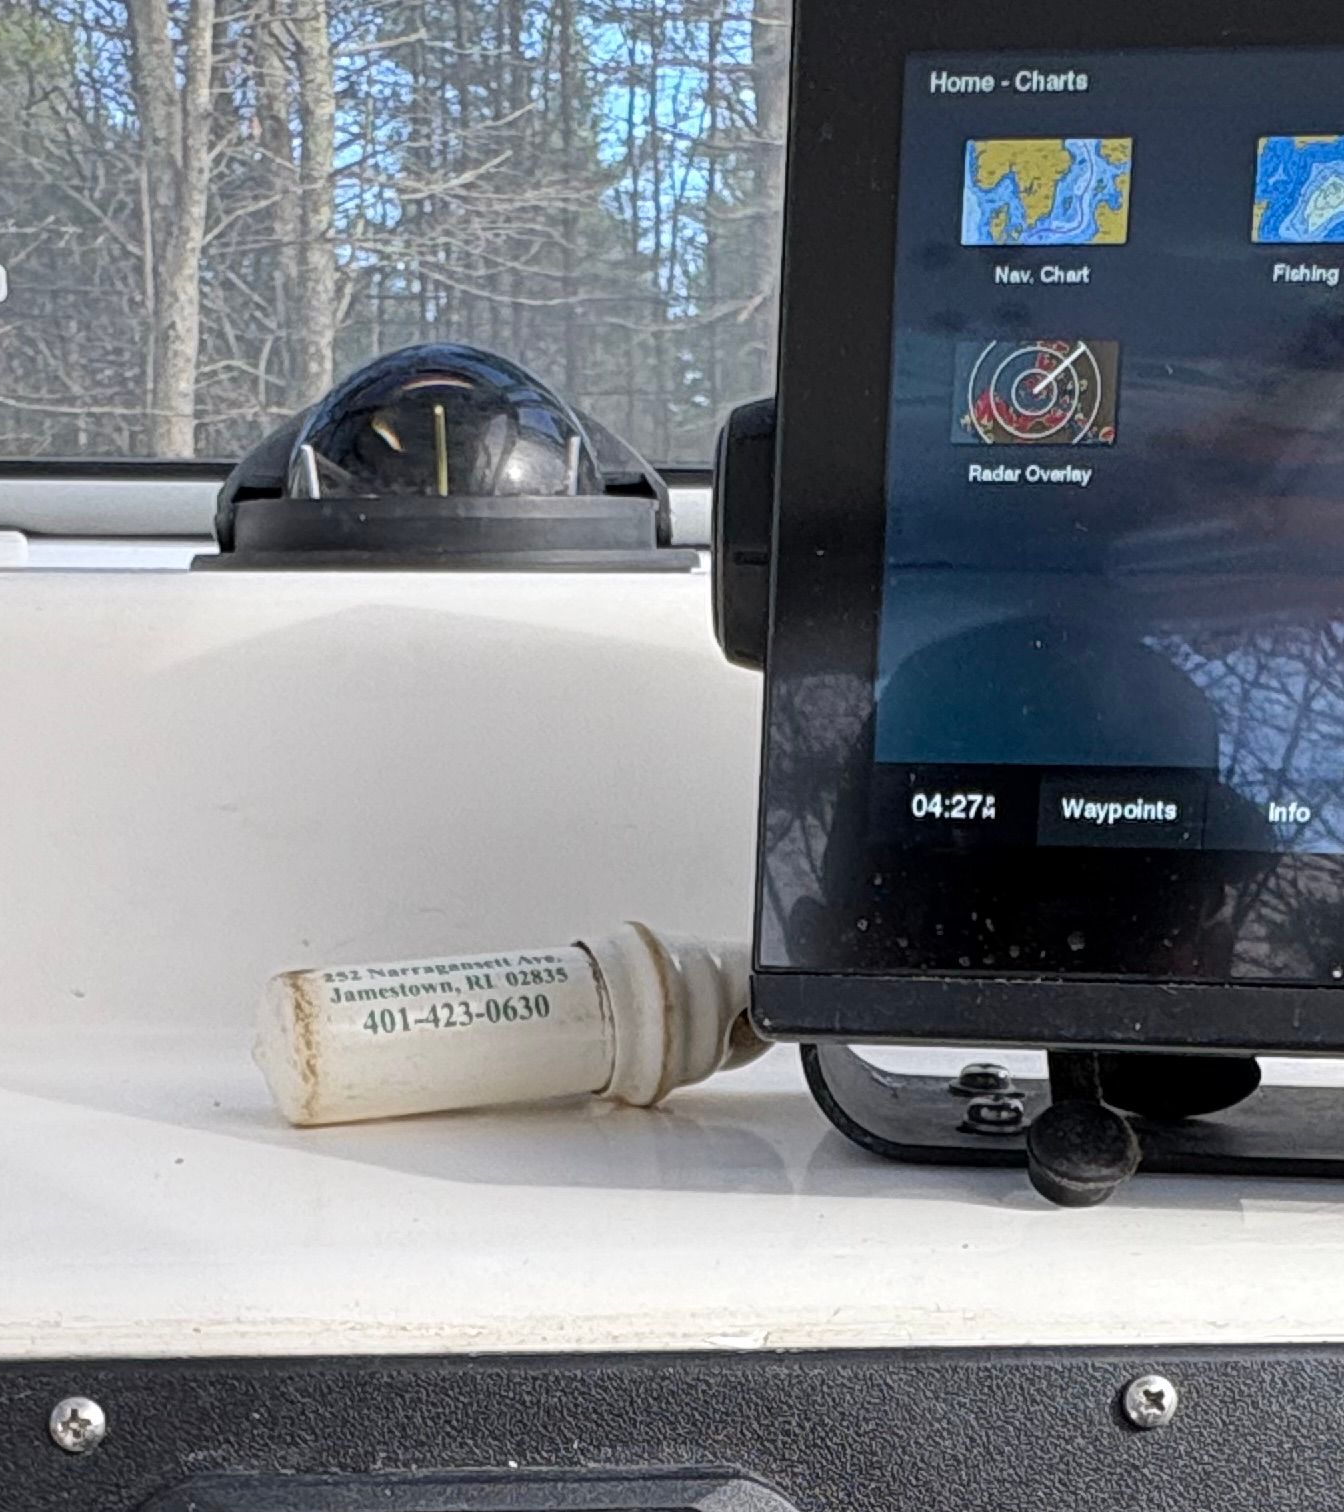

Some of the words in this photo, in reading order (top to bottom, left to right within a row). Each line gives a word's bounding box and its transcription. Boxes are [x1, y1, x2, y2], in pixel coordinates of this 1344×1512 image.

[930, 70, 995, 94] Home
[1014, 70, 1089, 94] Charts
[1040, 265, 1090, 284] Chart
[1272, 263, 1341, 287] Fishing
[968, 464, 1021, 483] Radar
[1025, 464, 1092, 486] Overlay
[912, 792, 983, 819] 04:27
[1062, 797, 1177, 824] Waypoints
[1268, 801, 1311, 824] Info
[323, 968, 362, 983] 252
[366, 956, 512, 979] Narragansett
[329, 979, 463, 1004] Jamestown,
[465, 973, 496, 992] RI
[505, 967, 569, 988] 02835
[363, 994, 551, 1035] 401-423-0630
